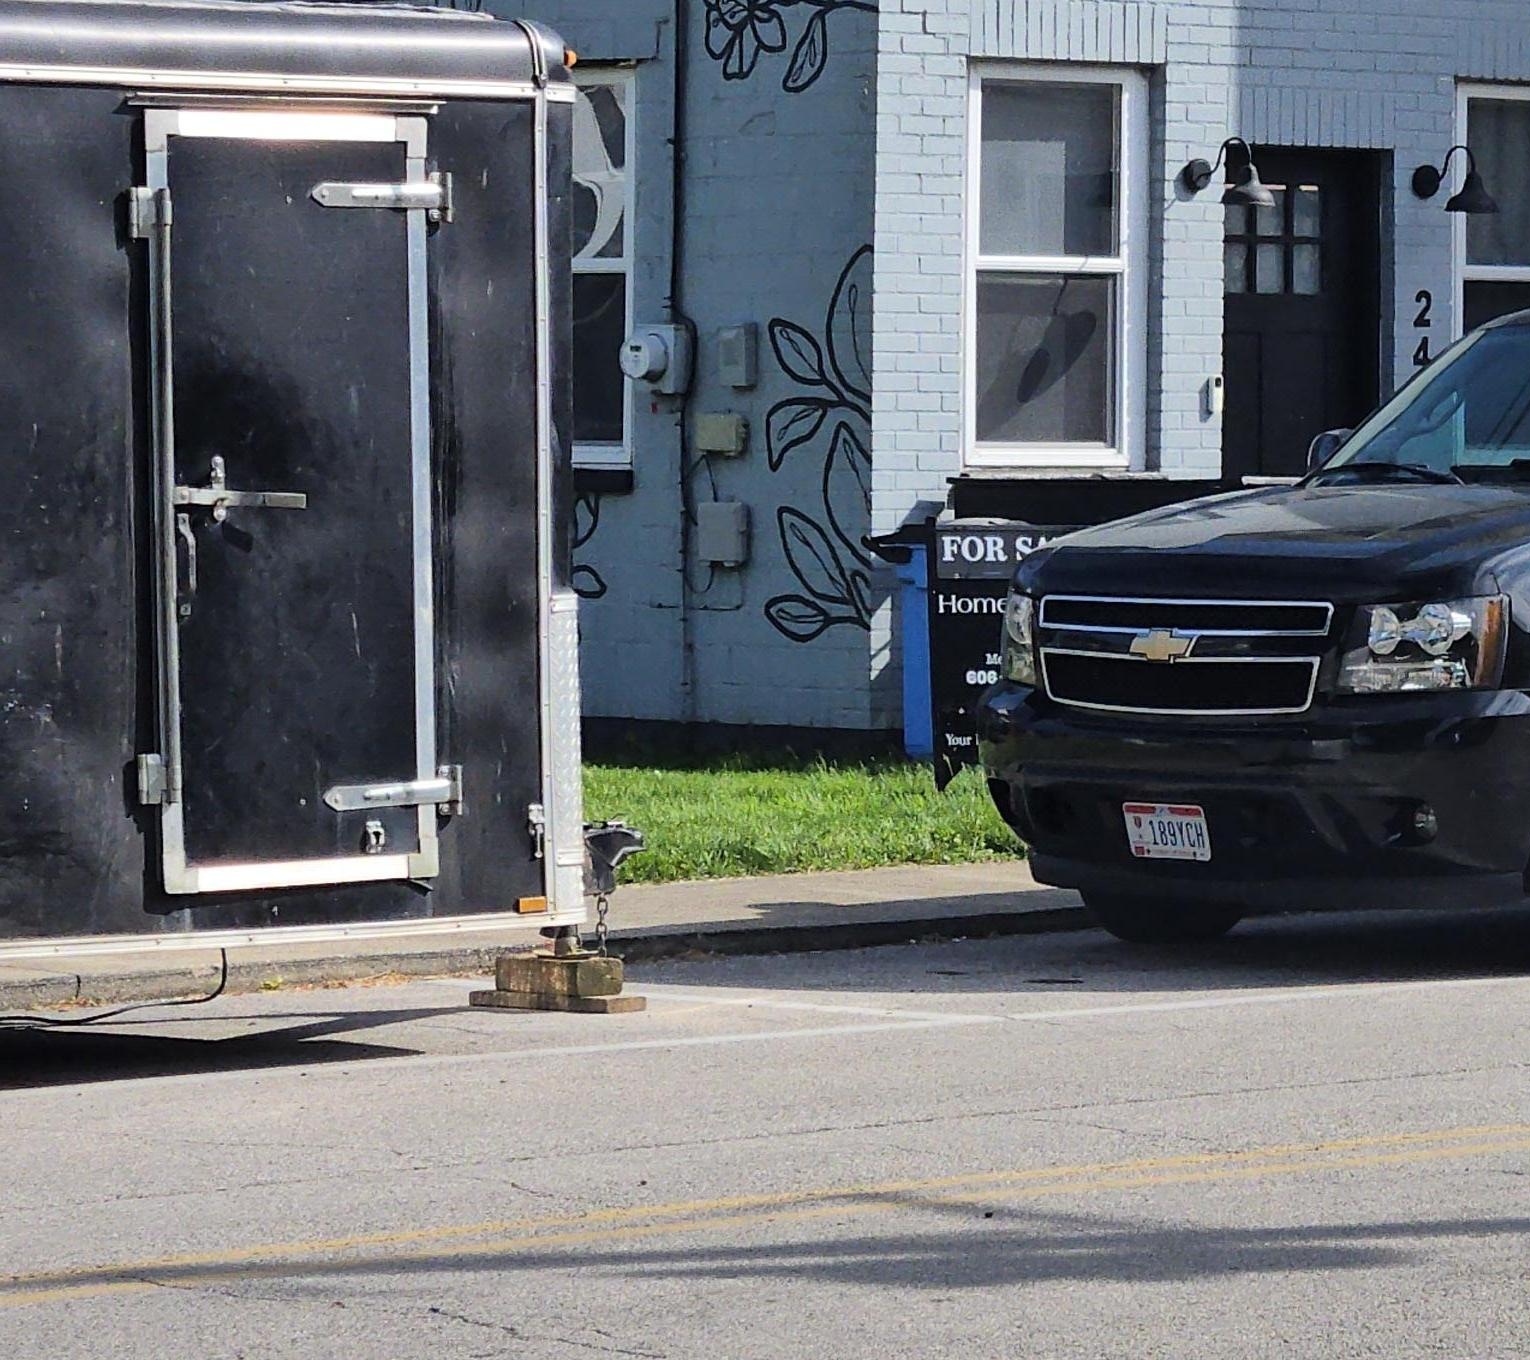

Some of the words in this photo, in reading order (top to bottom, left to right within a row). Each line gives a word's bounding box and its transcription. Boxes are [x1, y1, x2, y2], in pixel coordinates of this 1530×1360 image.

[941, 536, 1008, 562] FOR
[945, 733, 972, 746] Your
[1148, 820, 1206, 849] 189YCH
